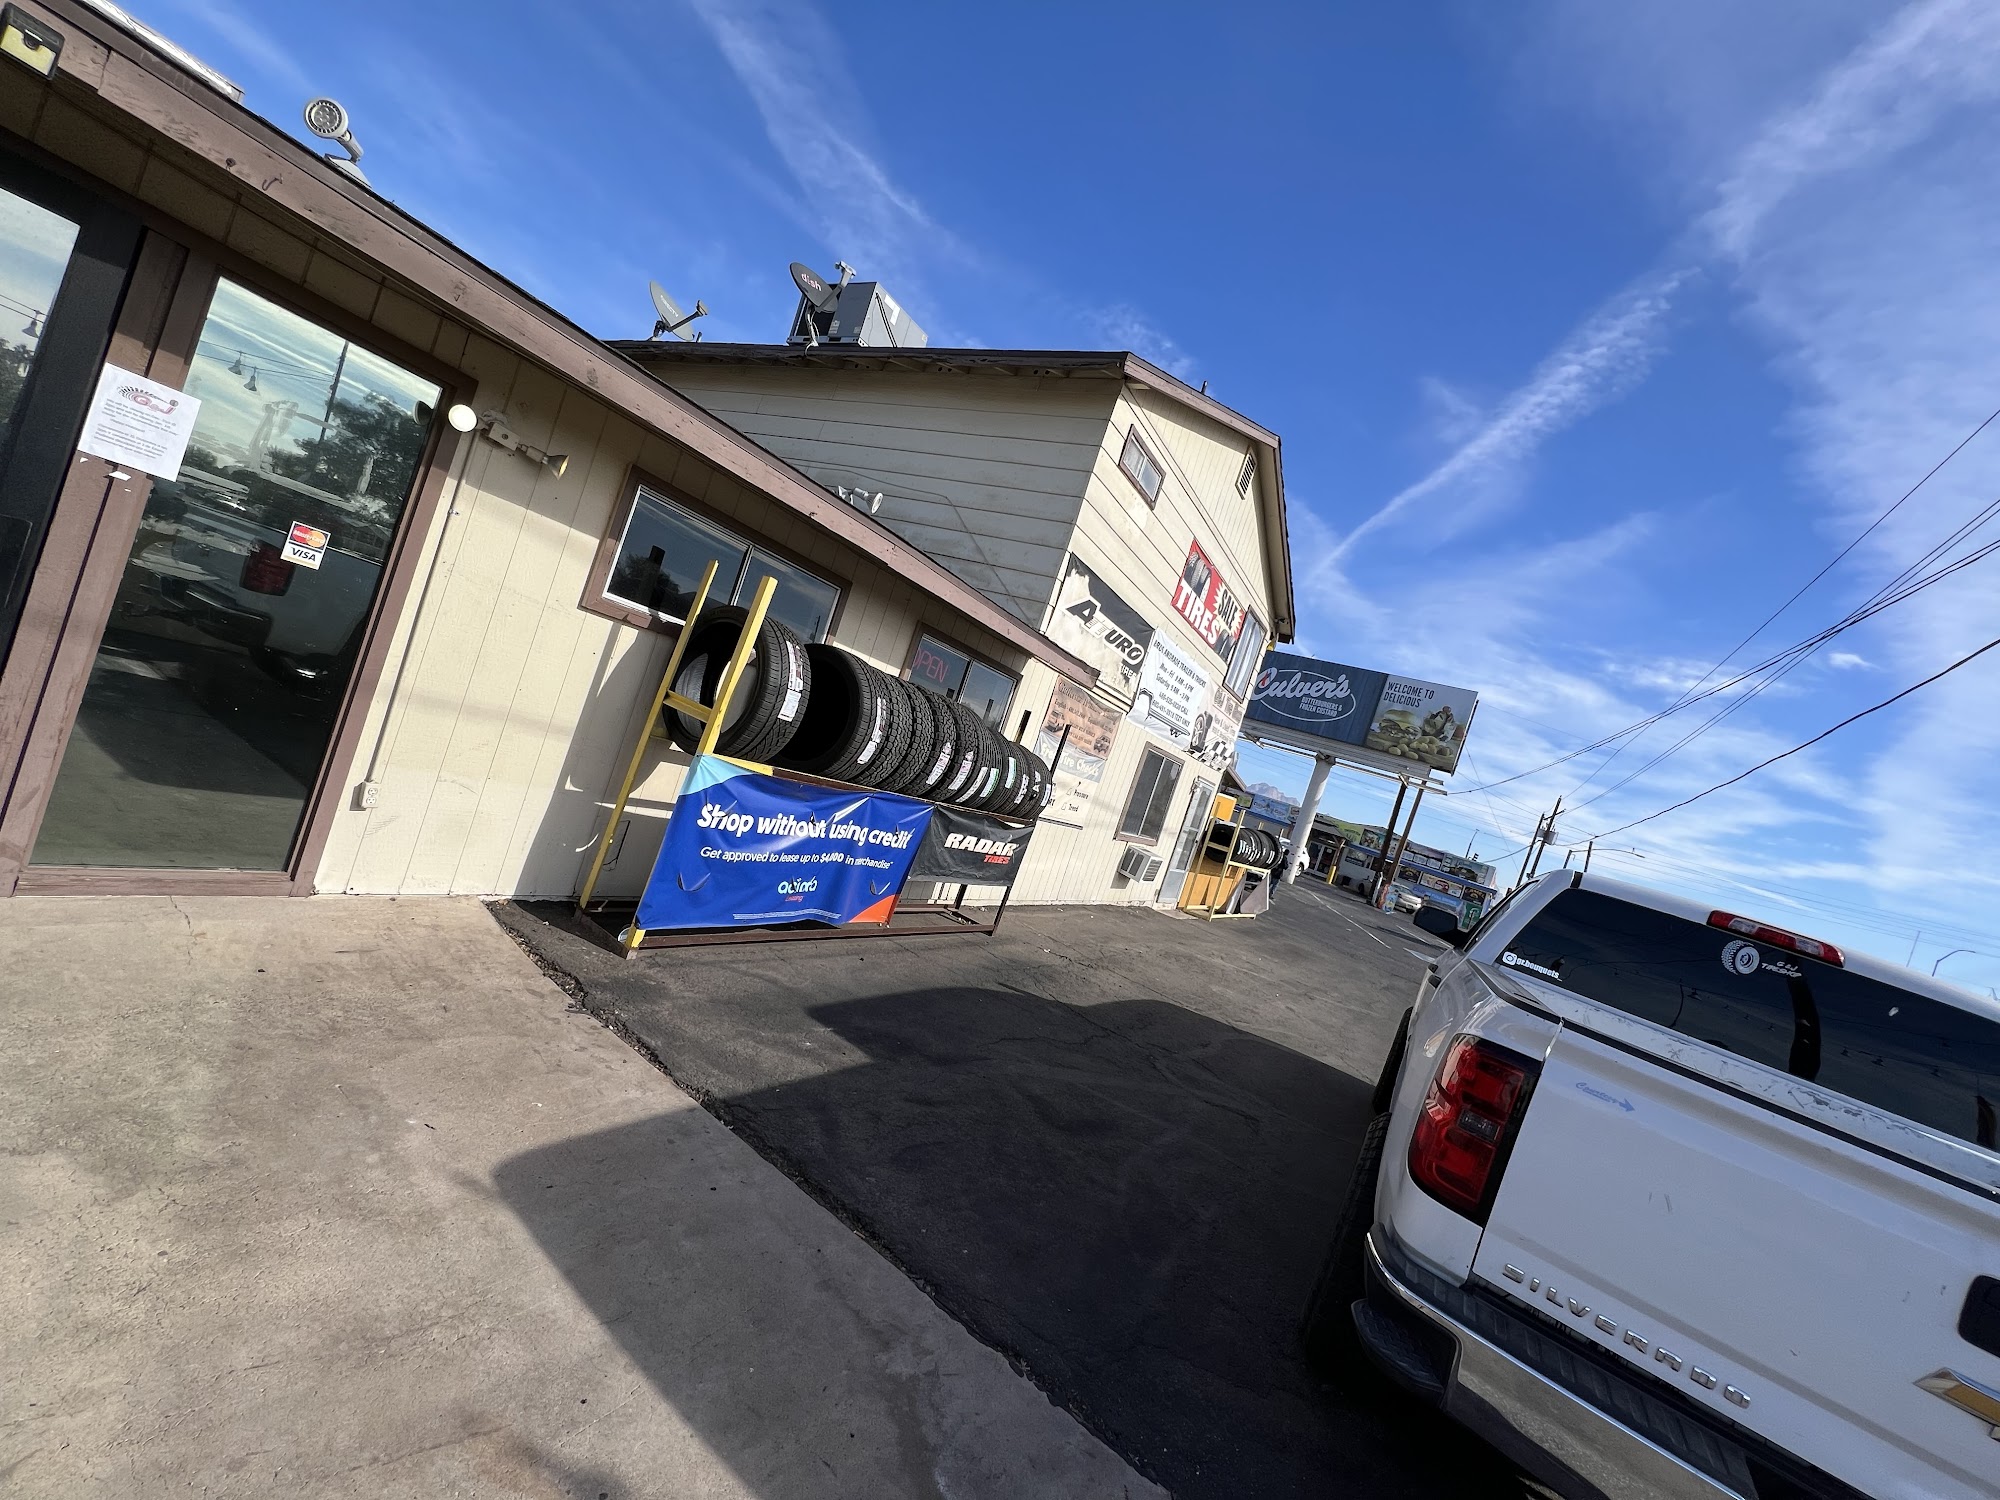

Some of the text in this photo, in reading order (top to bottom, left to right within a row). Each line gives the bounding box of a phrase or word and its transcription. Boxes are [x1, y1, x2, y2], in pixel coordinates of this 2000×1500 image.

[801, 273, 822, 292] dish
[291, 546, 316, 562] VISA
[1175, 577, 1221, 645] TIRES
[1218, 588, 1239, 631] SALE
[1251, 667, 1351, 700] Culver's
[1387, 681, 1435, 700] WELCOME TO
[1301, 696, 1338, 712] BUTTERBURGERS
[1383, 691, 1422, 708] DELICIOUS
[1299, 702, 1338, 717] FROZEN CUSTARD
[1060, 752, 1075, 767] Tire
[697, 803, 912, 849] Shop without using credit
[944, 833, 1019, 857] RADAR
[700, 847, 722, 859] Get
[722, 851, 769, 863] approved
[769, 852, 779, 863] to
[779, 852, 800, 863] lease
[800, 854, 811, 864] up
[811, 853, 820, 863] to
[845, 854, 854, 865] in
[984, 854, 1011, 865] TIRES
[1502, 1262, 1751, 1410] SILVERADO
